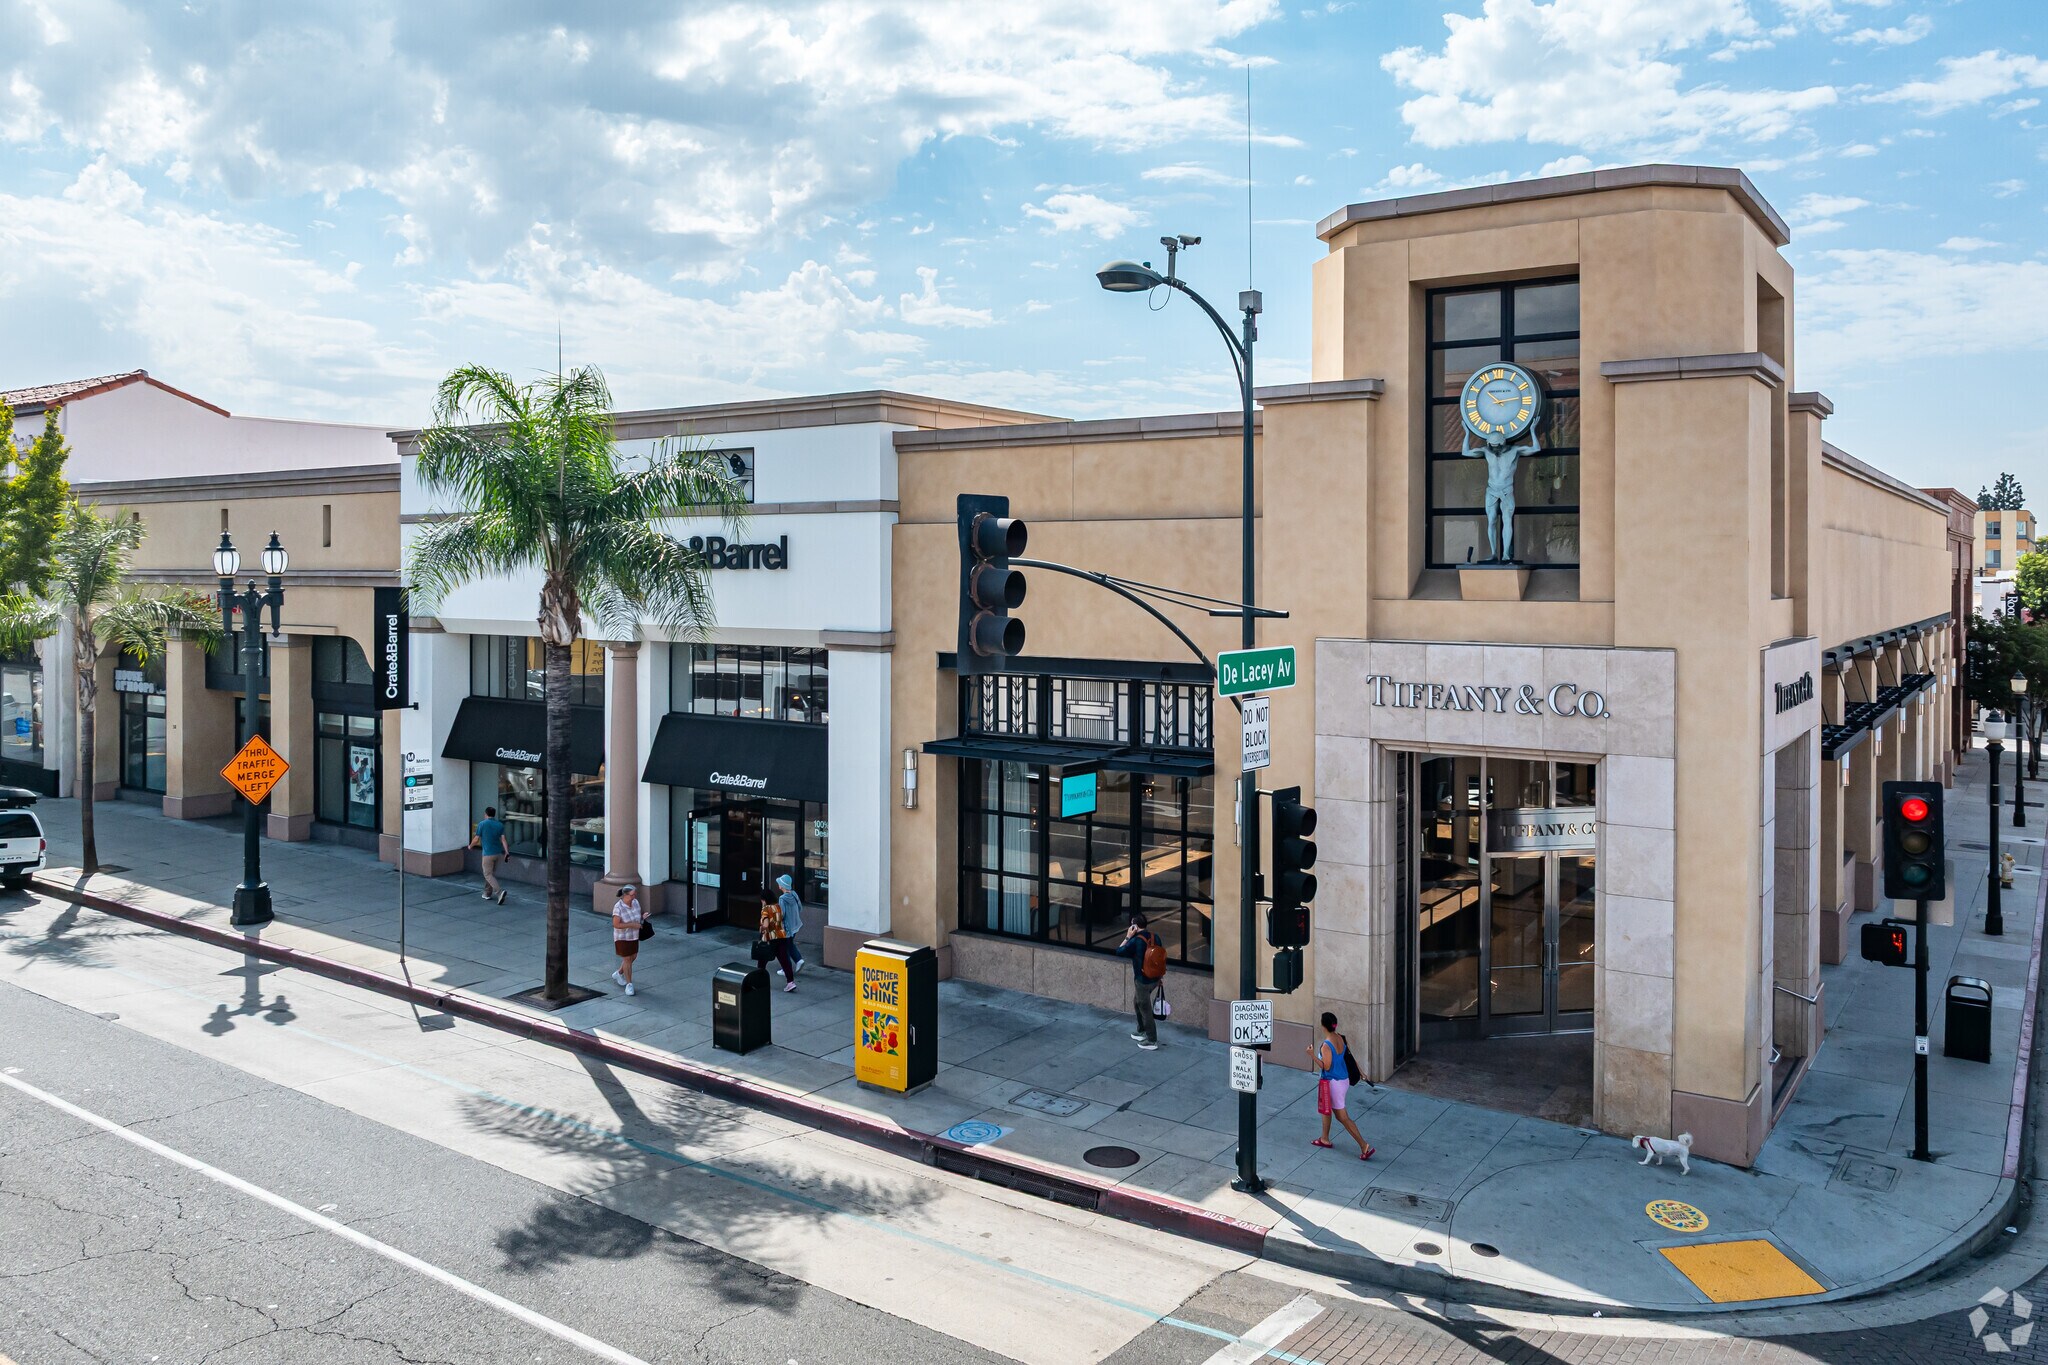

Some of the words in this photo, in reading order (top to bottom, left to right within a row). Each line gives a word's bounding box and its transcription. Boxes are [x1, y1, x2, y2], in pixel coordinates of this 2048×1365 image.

[385, 614, 398, 699] Crate&Barrel
[1223, 663, 1238, 685] De
[1241, 662, 1274, 685] Lacey
[1277, 658, 1291, 678] Av
[1366, 674, 1511, 713] TIFFANY
[1513, 684, 1544, 715] &
[1243, 709, 1252, 725] DO
[1256, 706, 1268, 723] NOT
[1245, 729, 1267, 748] BLOCK
[245, 748, 269, 757] THRU
[495, 747, 542, 763] Crate&Barrel
[1243, 748, 1269, 763] INTERSECTION
[237, 758, 275, 770] TRAFFIC
[237, 769, 275, 781] MERGE
[709, 771, 767, 789] Crate&Barrel
[244, 781, 269, 792] LEFT
[1567, 823, 1578, 836] &
[1892, 933, 1902, 953] 4
[862, 966, 898, 982] TOGETHER
[863, 983, 898, 1006] SHINE
[879, 981, 898, 995] WE
[1234, 1004, 1269, 1012] DIAGONAL
[1234, 1012, 1269, 1020] CROSSING
[1234, 1026, 1250, 1039] OK
[1234, 1051, 1254, 1060] CROSS
[1235, 1065, 1252, 1073] WALK
[1232, 1071, 1254, 1081] SIGNAL
[1235, 1079, 1251, 1087] ONLY
[1202, 1210, 1226, 1222] BUS
